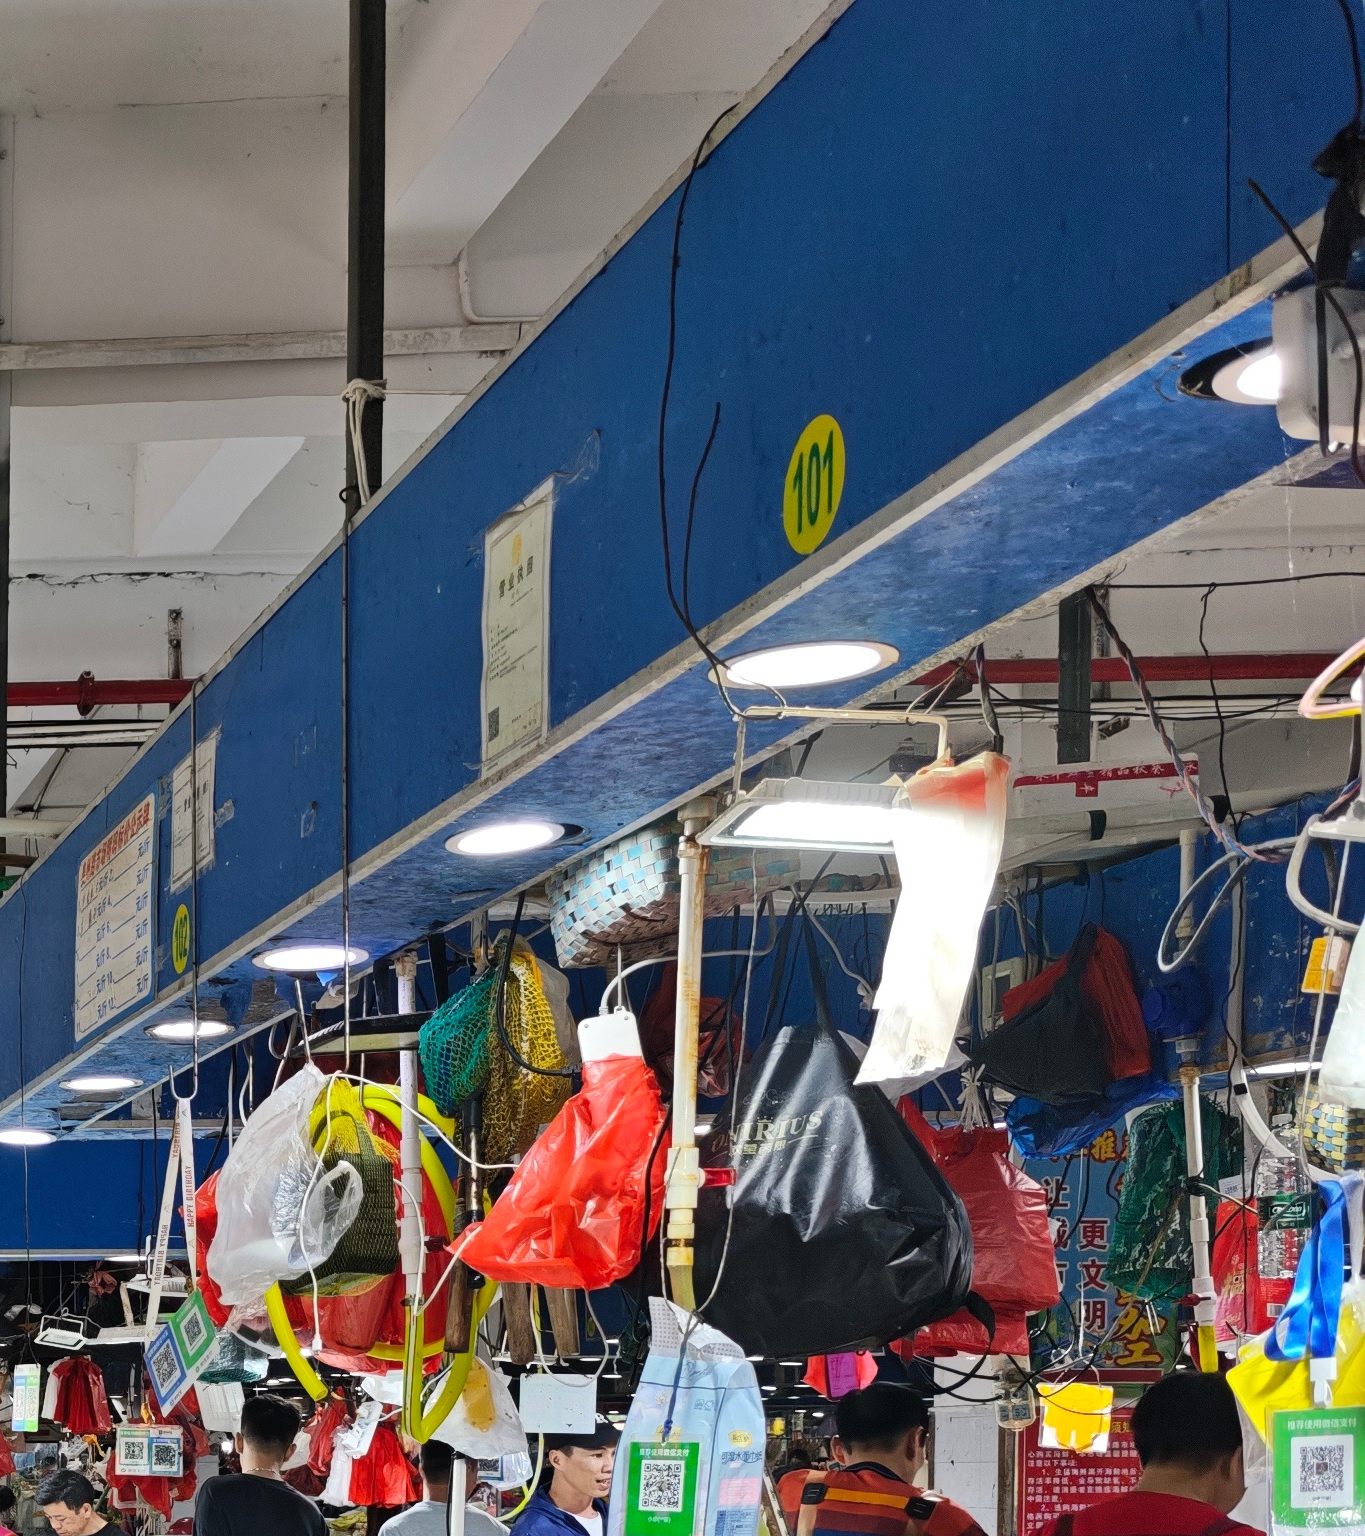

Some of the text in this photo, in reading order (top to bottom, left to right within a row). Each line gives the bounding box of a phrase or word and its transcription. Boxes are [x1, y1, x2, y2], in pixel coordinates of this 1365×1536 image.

[792, 430, 835, 535] 101
[187, 1202, 195, 1228] HAPPY
[1076, 1217, 1110, 1333] 更文明
